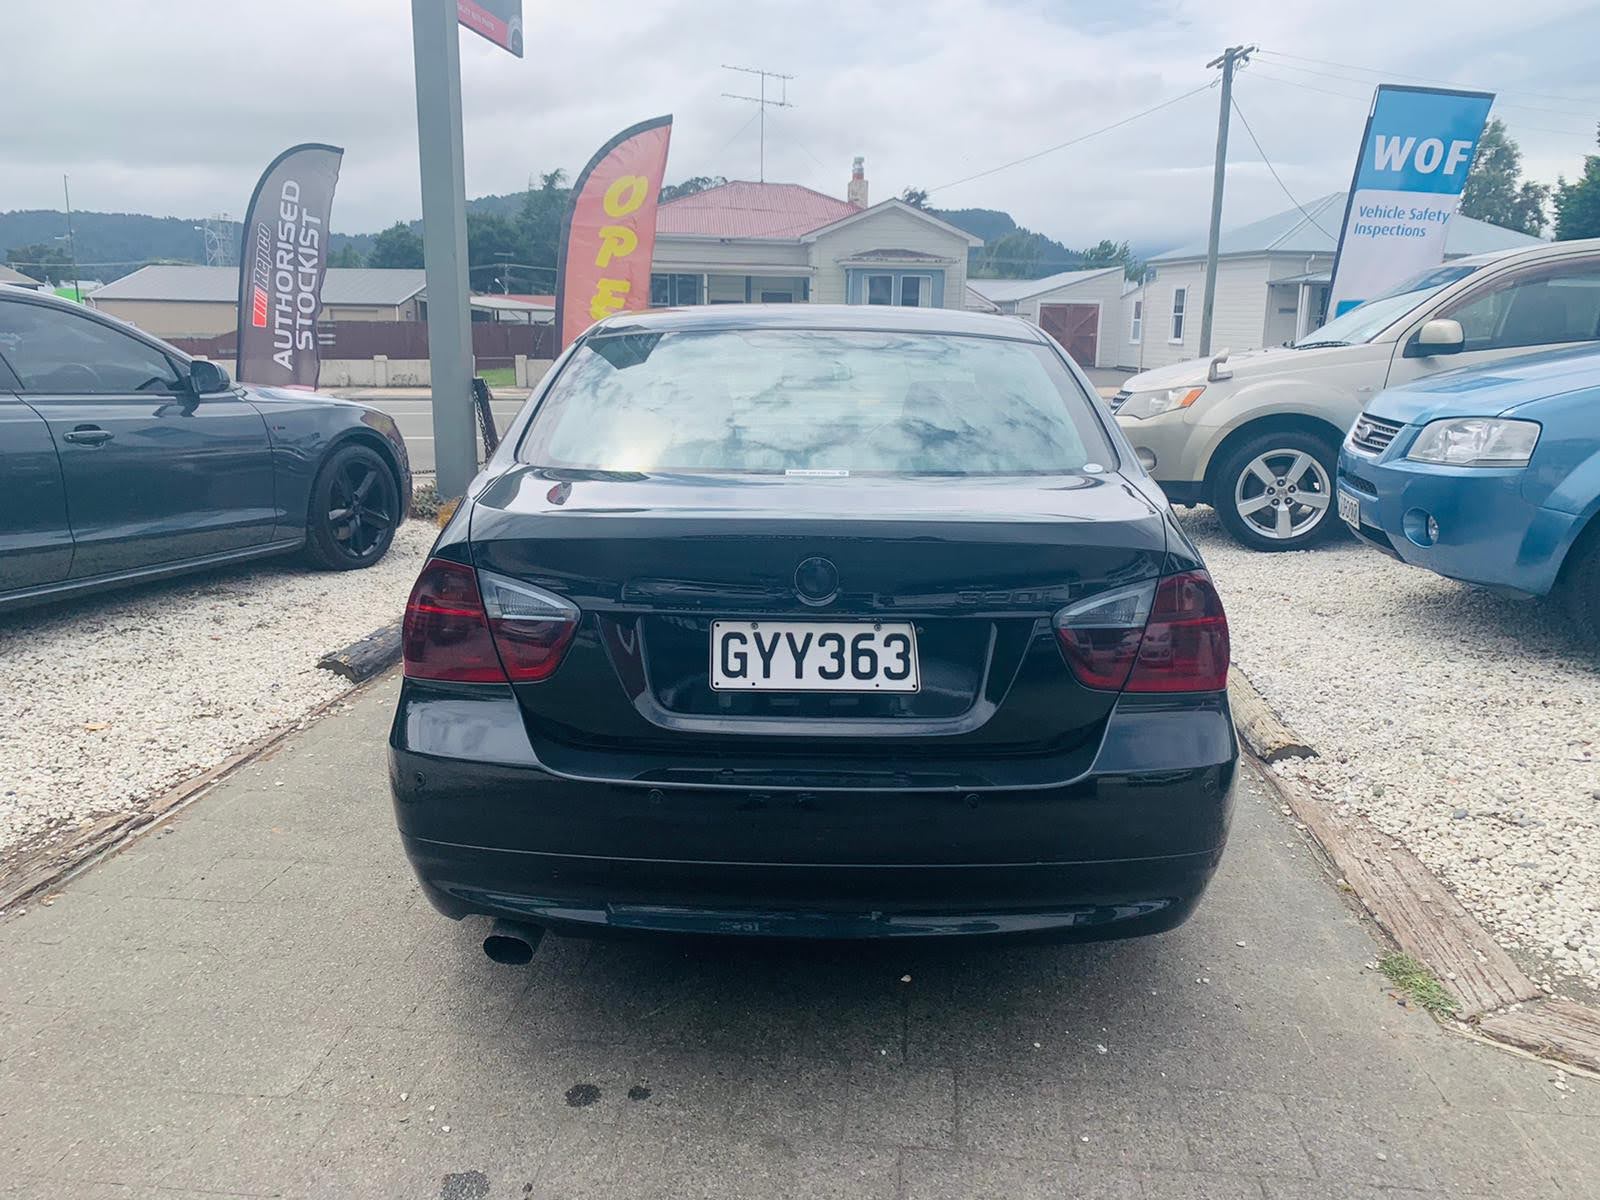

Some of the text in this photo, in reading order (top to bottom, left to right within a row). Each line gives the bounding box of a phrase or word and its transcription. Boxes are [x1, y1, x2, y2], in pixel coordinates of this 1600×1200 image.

[1374, 135, 1473, 175] WOF
[1354, 223, 1426, 238] Inspections
[1359, 205, 1450, 225] Vehicle Safety
[590, 175, 649, 320] OPE
[272, 179, 301, 372] AUTHORISED
[295, 207, 321, 350] STOCKIST
[720, 631, 911, 681] GYY363
